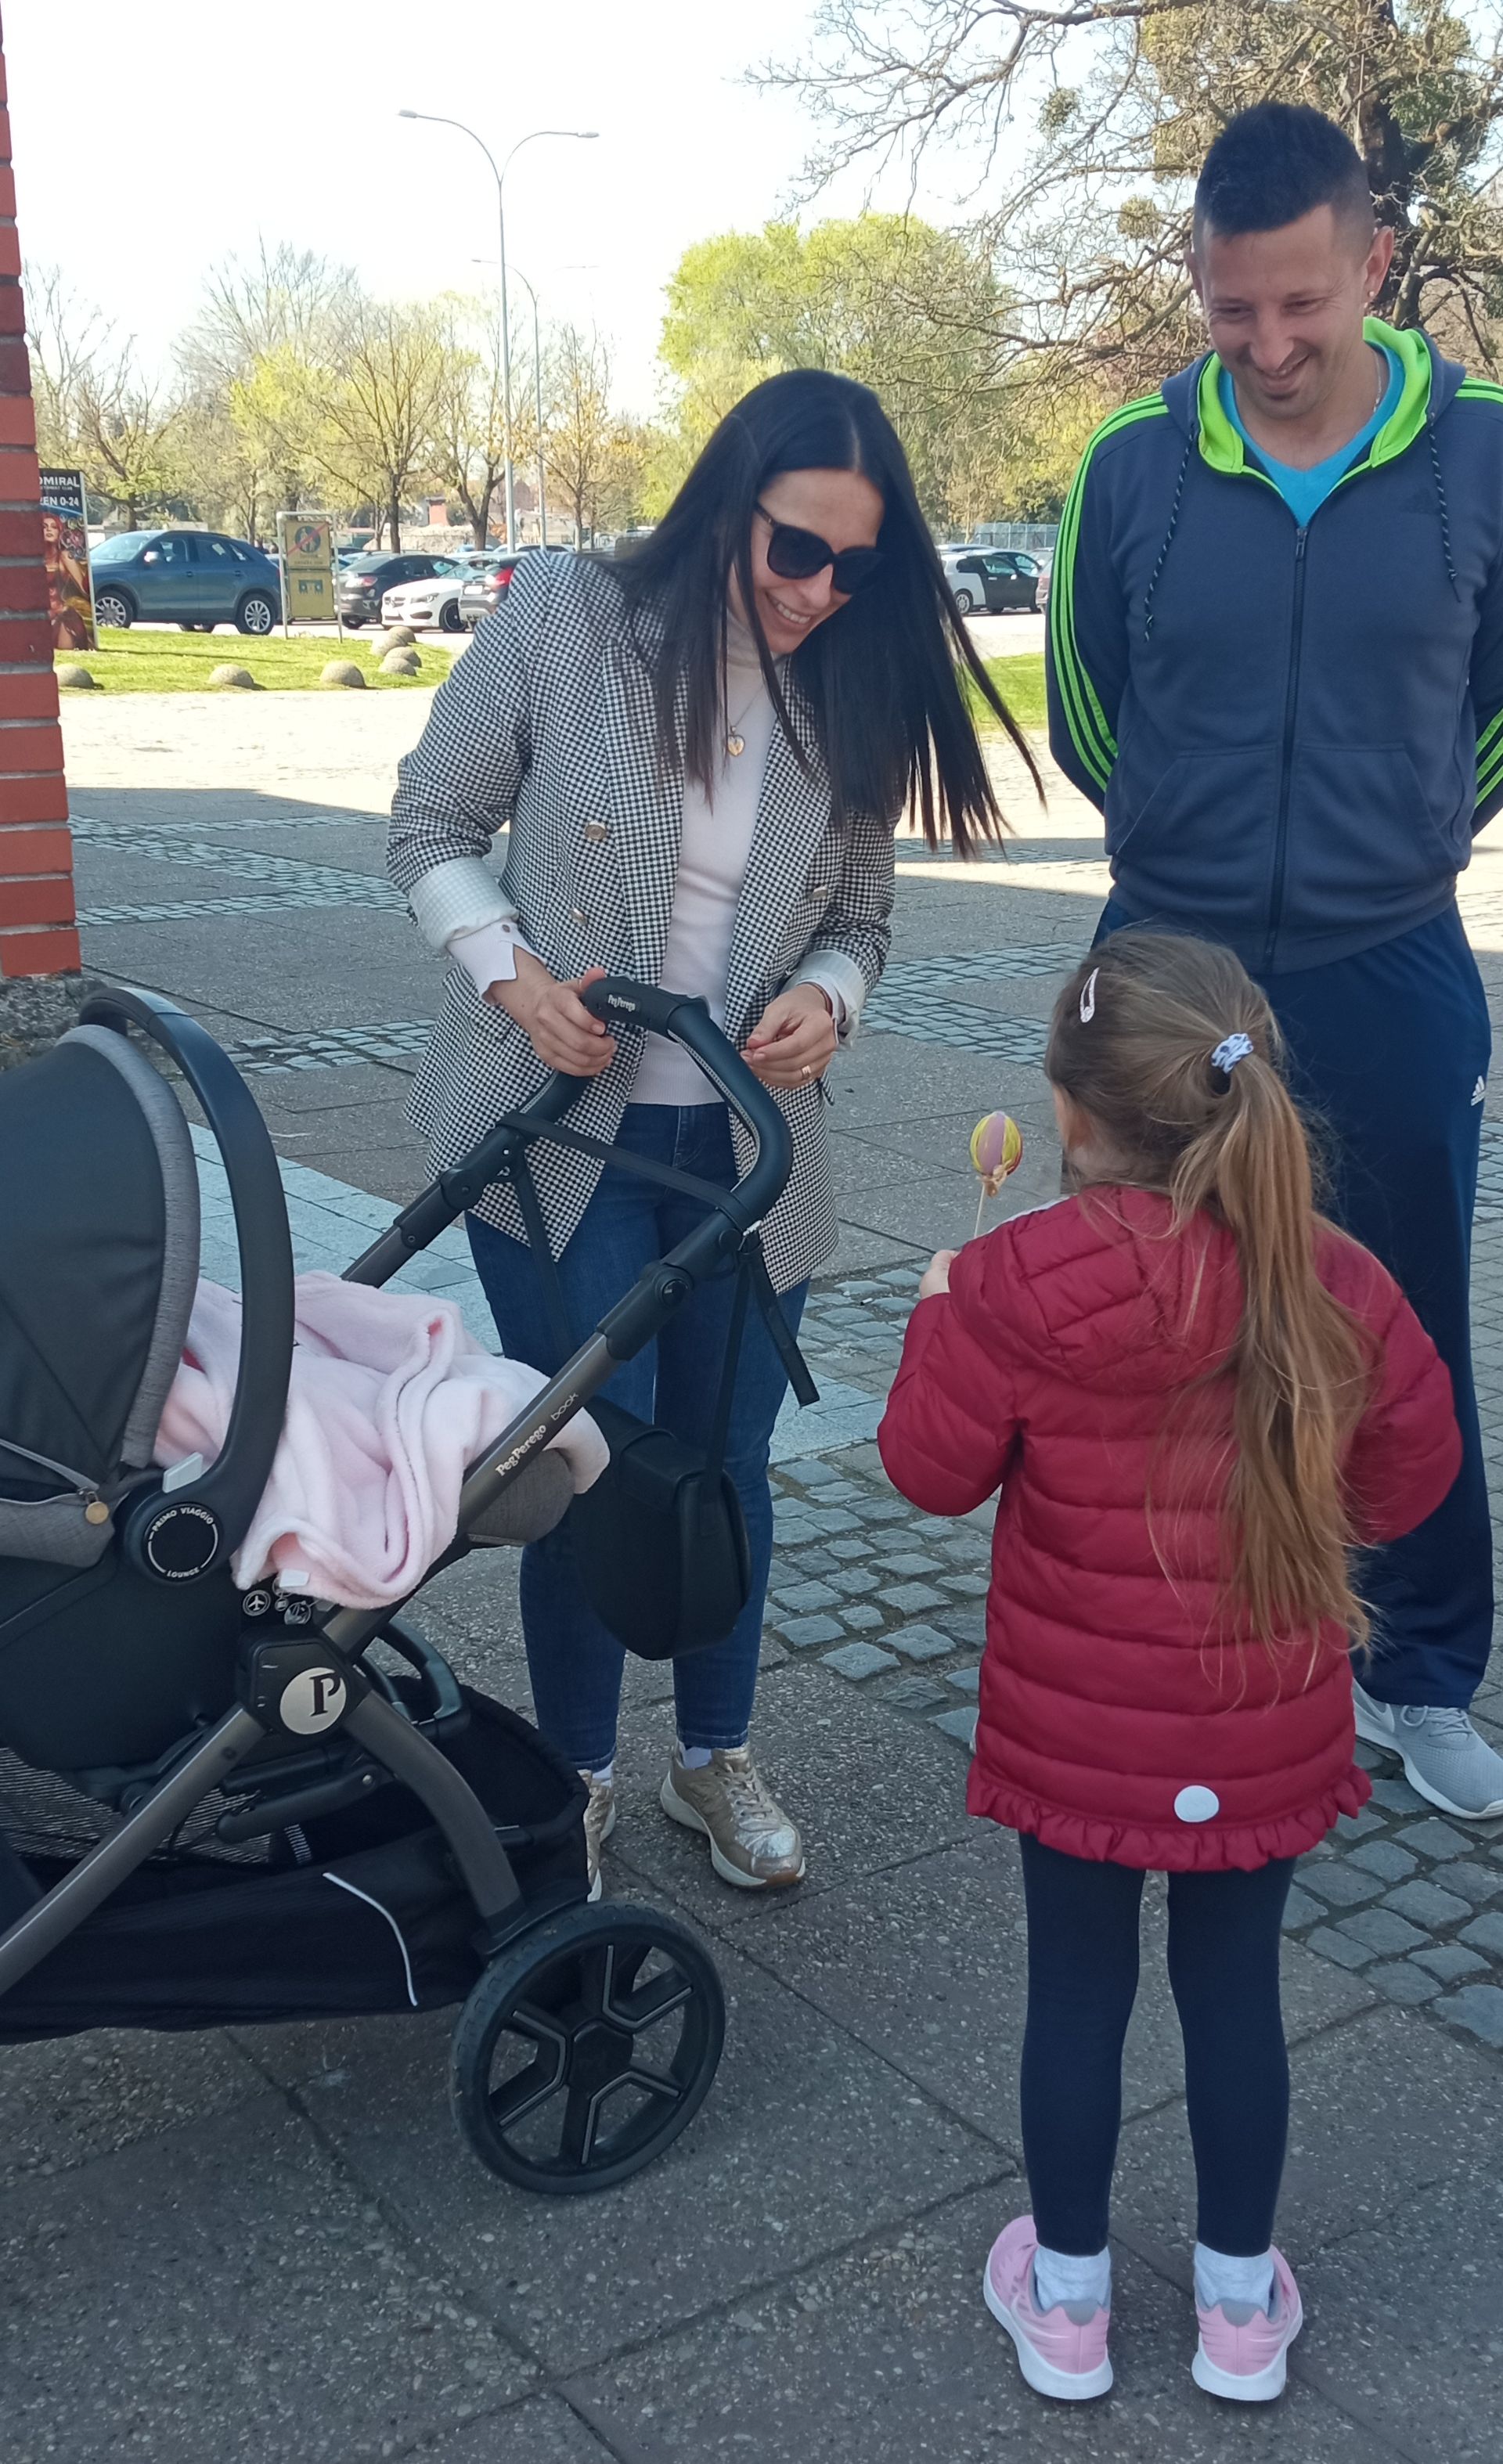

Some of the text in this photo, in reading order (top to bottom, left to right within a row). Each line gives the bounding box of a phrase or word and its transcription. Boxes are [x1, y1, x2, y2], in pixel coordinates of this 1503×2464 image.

[59, 496, 79, 506] 0-24
[495, 1392, 578, 1476] PegPerego book
[152, 1507, 214, 1531] PRIMO VIAGGIO
[167, 1567, 200, 1578] LOUNGE
[309, 1672, 341, 1717] P
